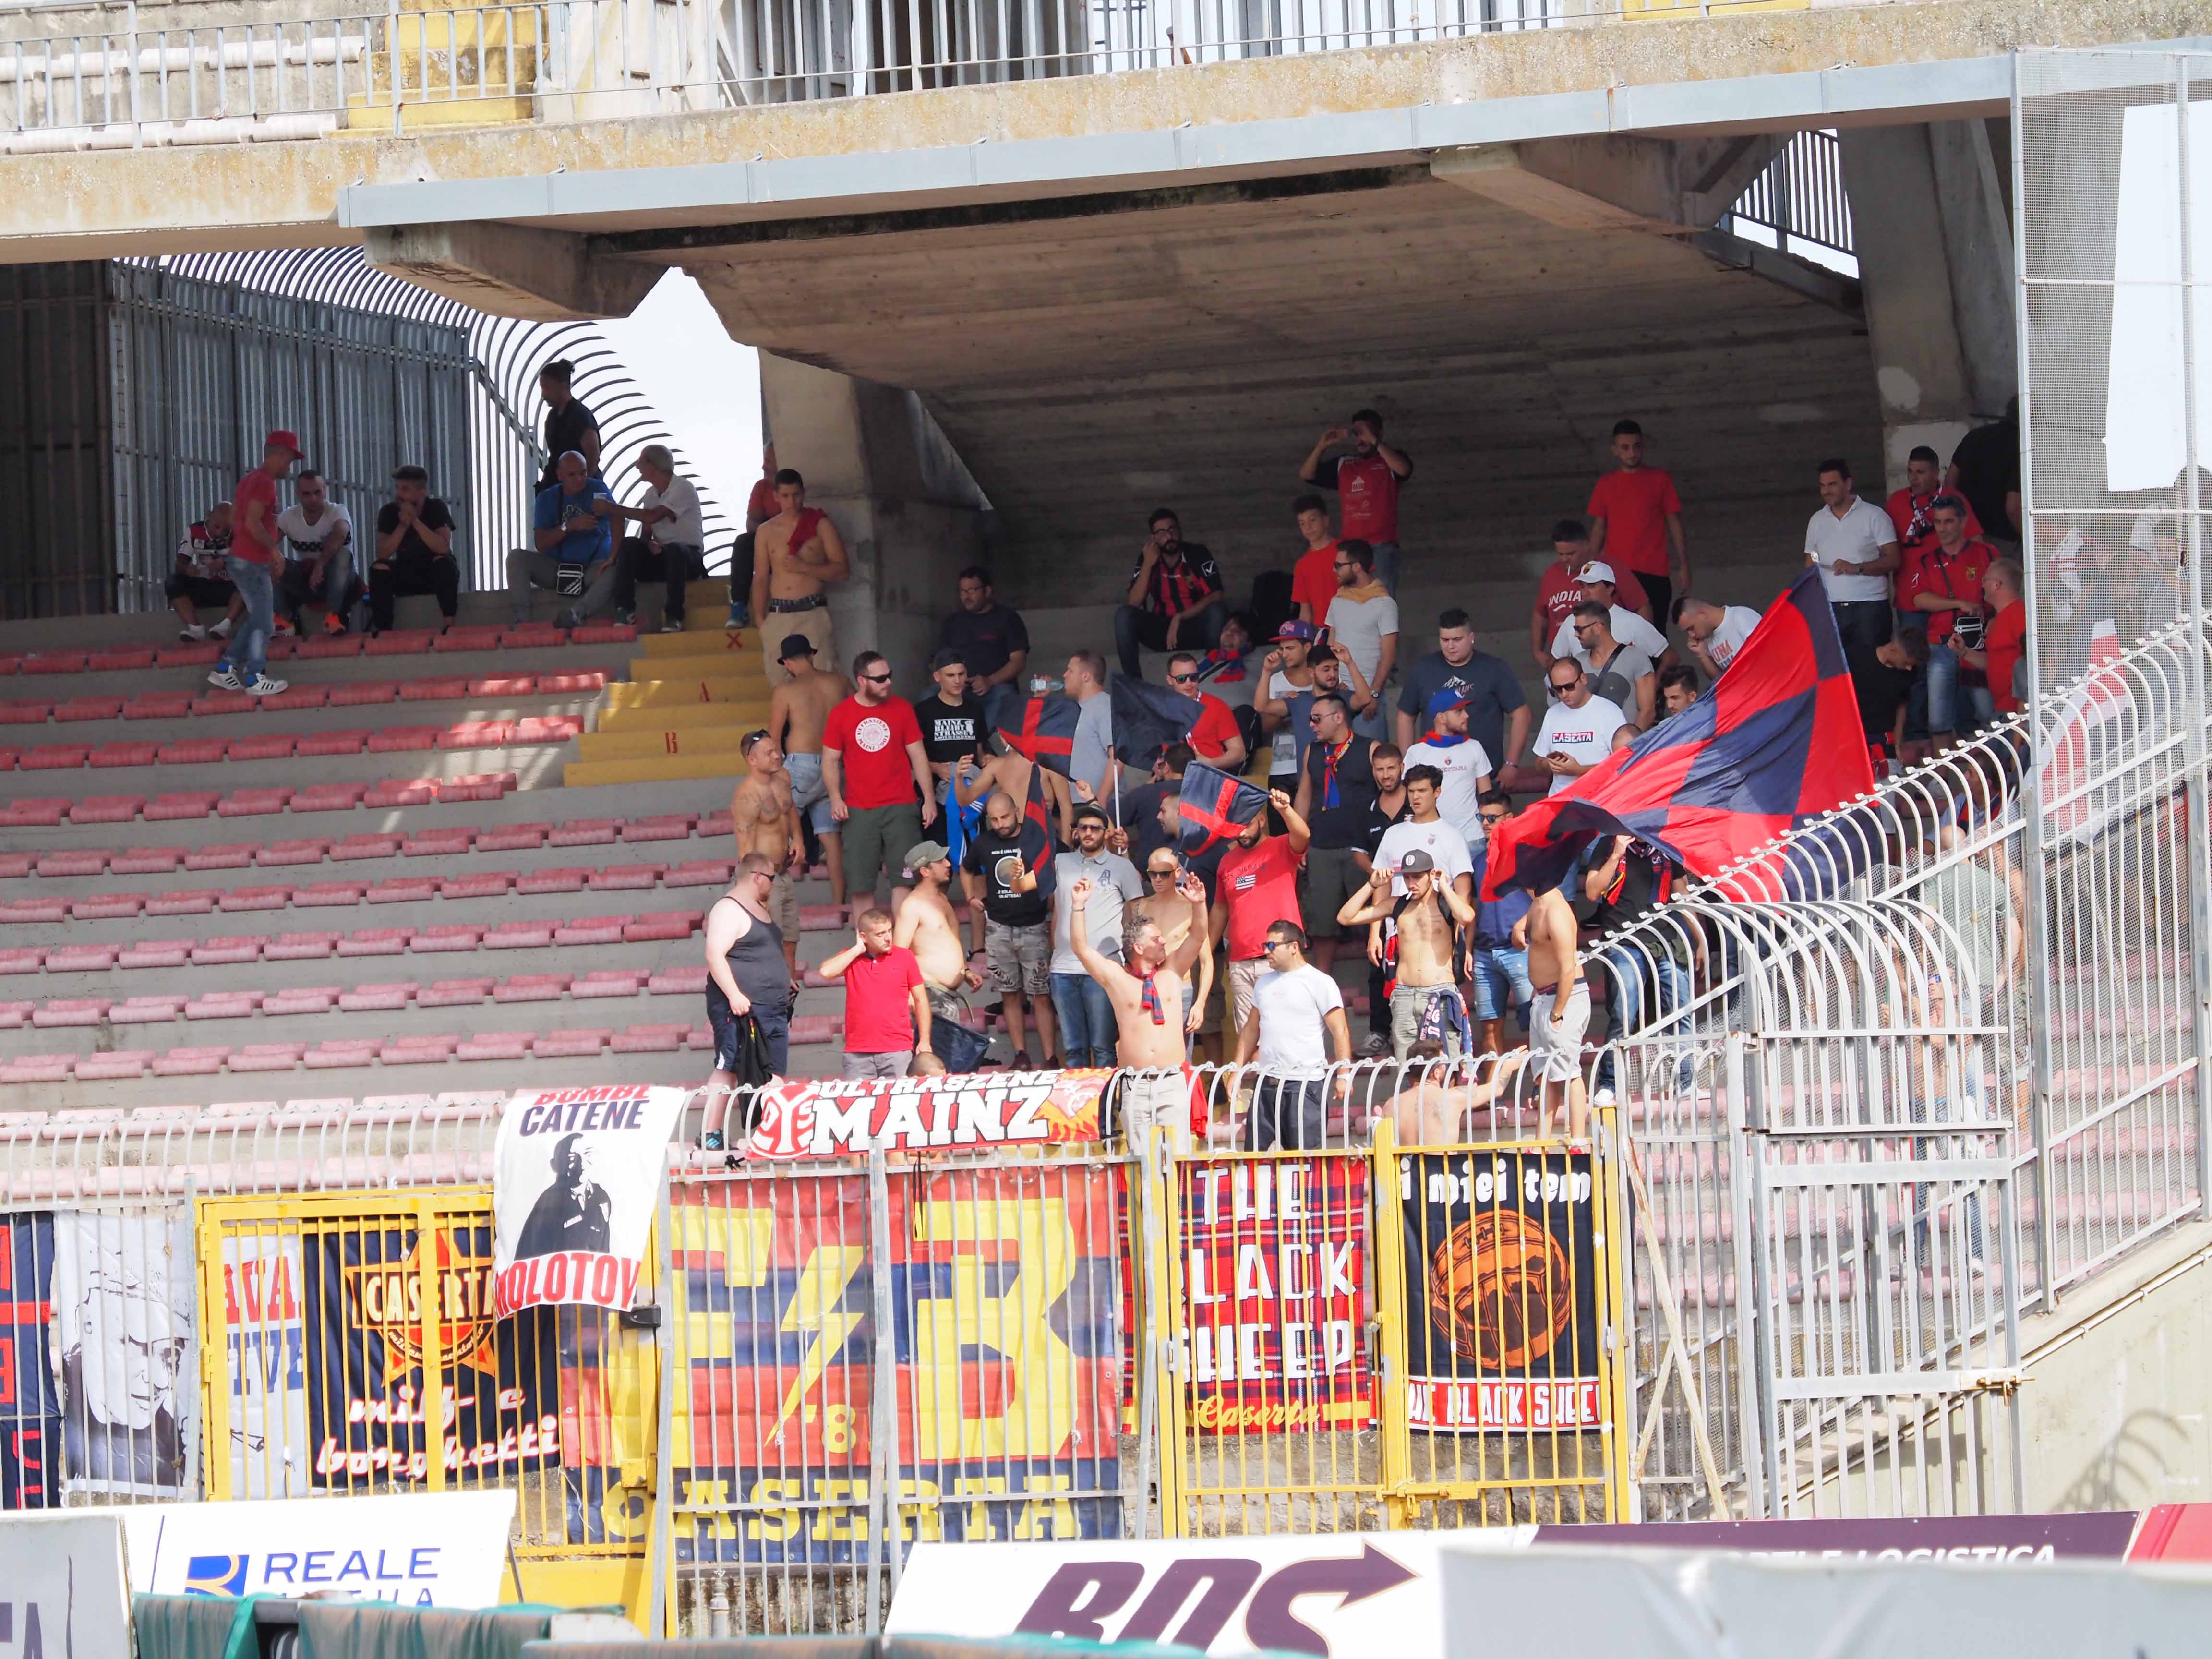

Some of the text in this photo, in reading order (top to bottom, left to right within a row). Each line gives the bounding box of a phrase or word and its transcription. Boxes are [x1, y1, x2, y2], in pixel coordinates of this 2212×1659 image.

[1552, 732, 1592, 743] CASERTA
[819, 1068, 1066, 1098] ULTRASZENE
[519, 1099, 650, 1137] CATENE
[809, 1085, 1052, 1154] MAINZ
[1196, 1163, 1311, 1225] THE
[1428, 1158, 1507, 1204] miei
[495, 1252, 641, 1319] MOLOTOV
[1181, 1240, 1357, 1305] LACK
[1194, 1395, 1320, 1429] Caserta
[1534, 1383, 1601, 1426] SHEE
[263, 1547, 441, 1585] REALE
